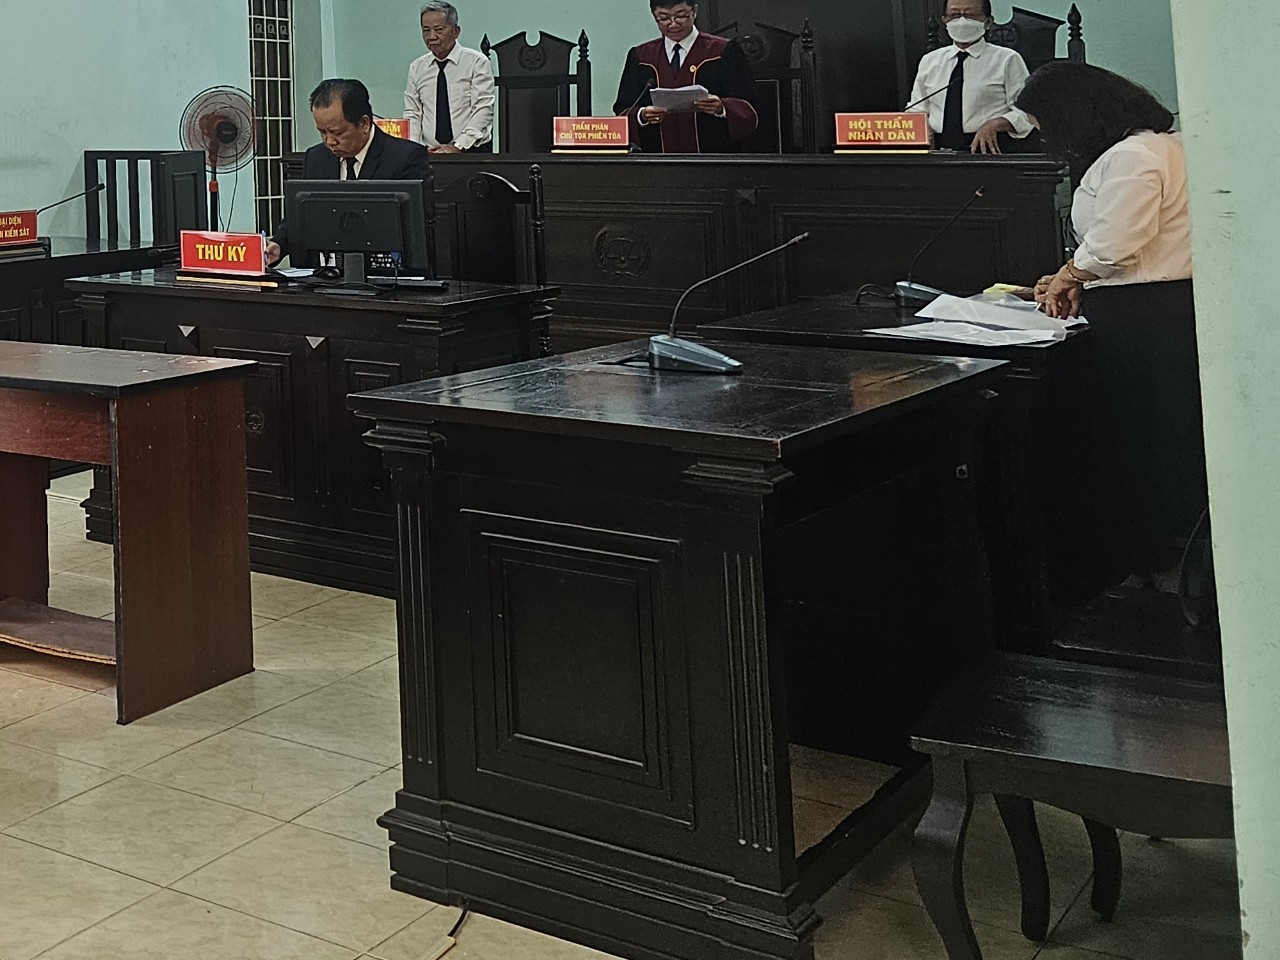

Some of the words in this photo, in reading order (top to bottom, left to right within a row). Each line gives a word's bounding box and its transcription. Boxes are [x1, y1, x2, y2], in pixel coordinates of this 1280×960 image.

[848, 118, 872, 130] HỘI
[875, 116, 913, 129] THẨM
[848, 129, 884, 140] NHÂN
[888, 129, 916, 140] DÂN
[19, 226, 30, 237] SÁT
[195, 242, 225, 261] THƯ
[227, 242, 247, 262] KÝ
